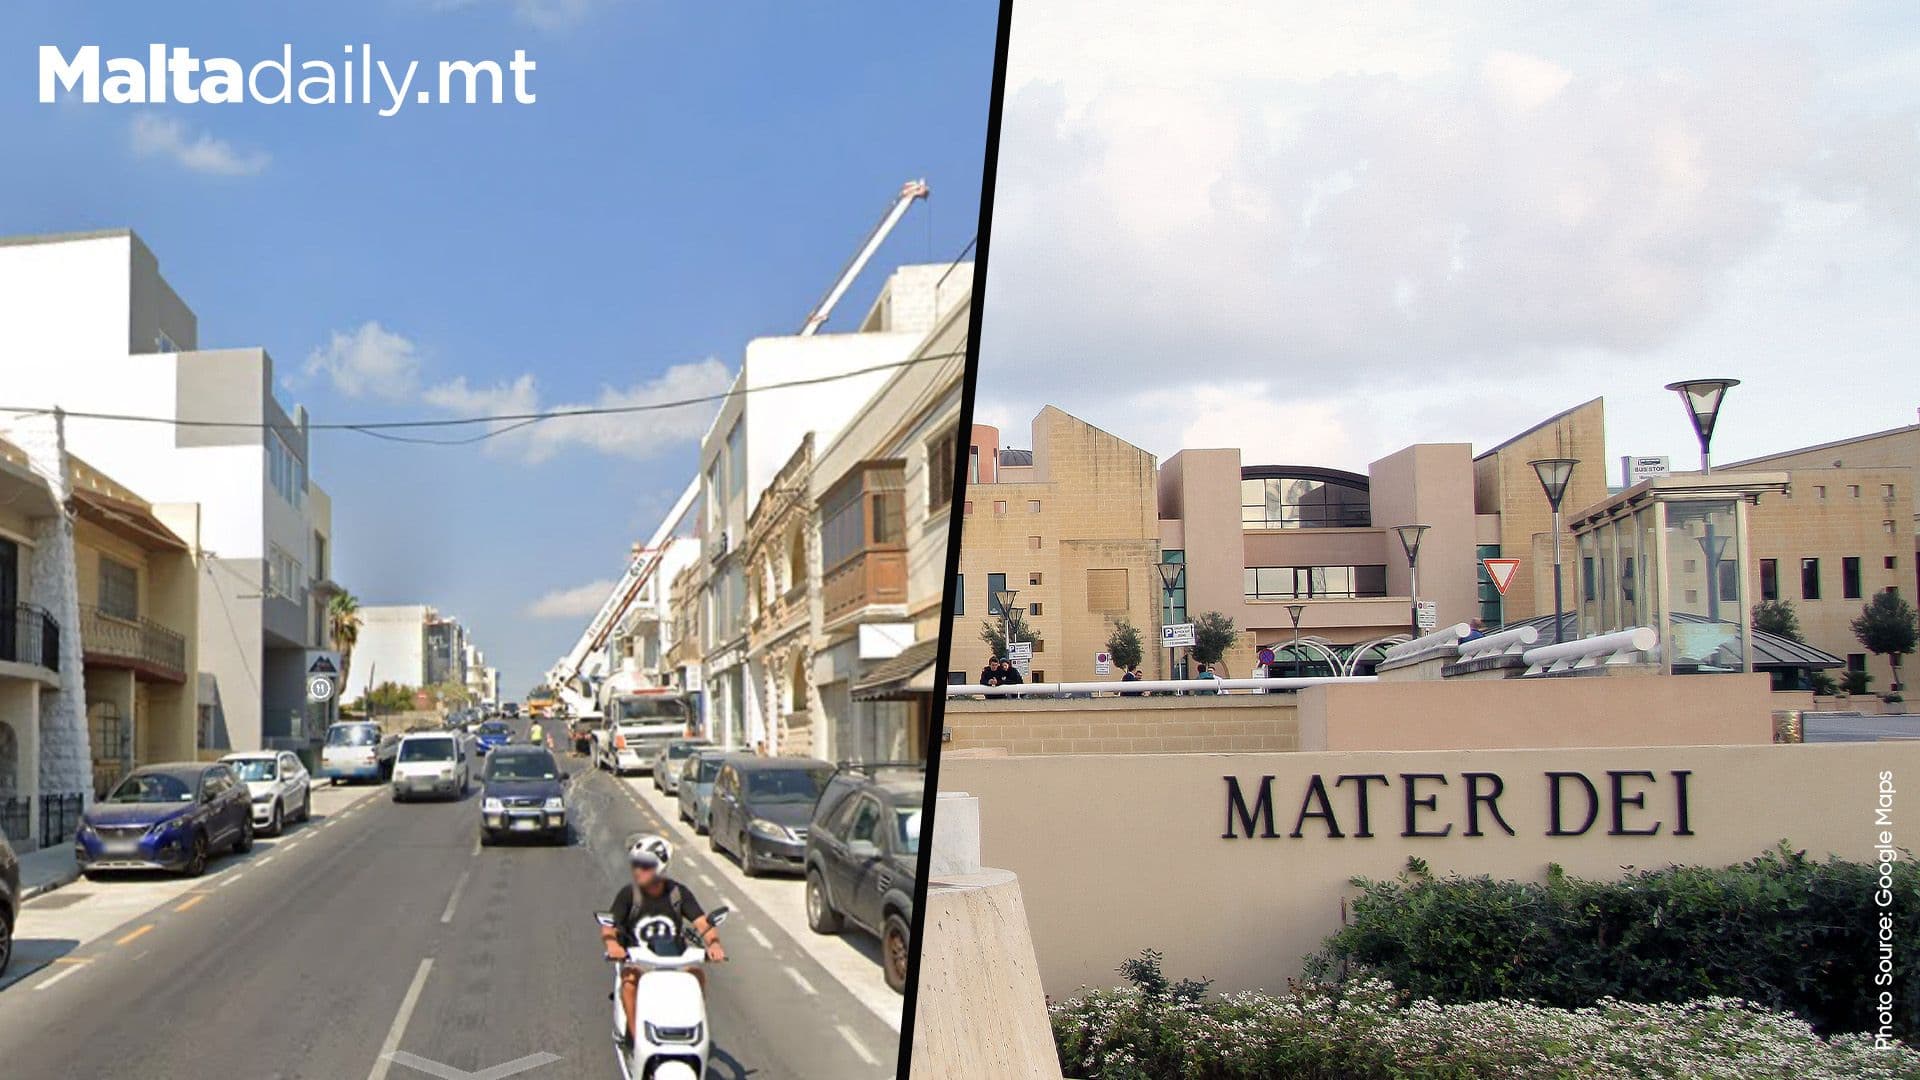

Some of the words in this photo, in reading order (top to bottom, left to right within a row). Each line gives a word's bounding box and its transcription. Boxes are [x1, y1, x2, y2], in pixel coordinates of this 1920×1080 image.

[1165, 628, 1173, 637] P
[1220, 771, 1516, 840] MATER
[1543, 769, 1695, 838] DEI
